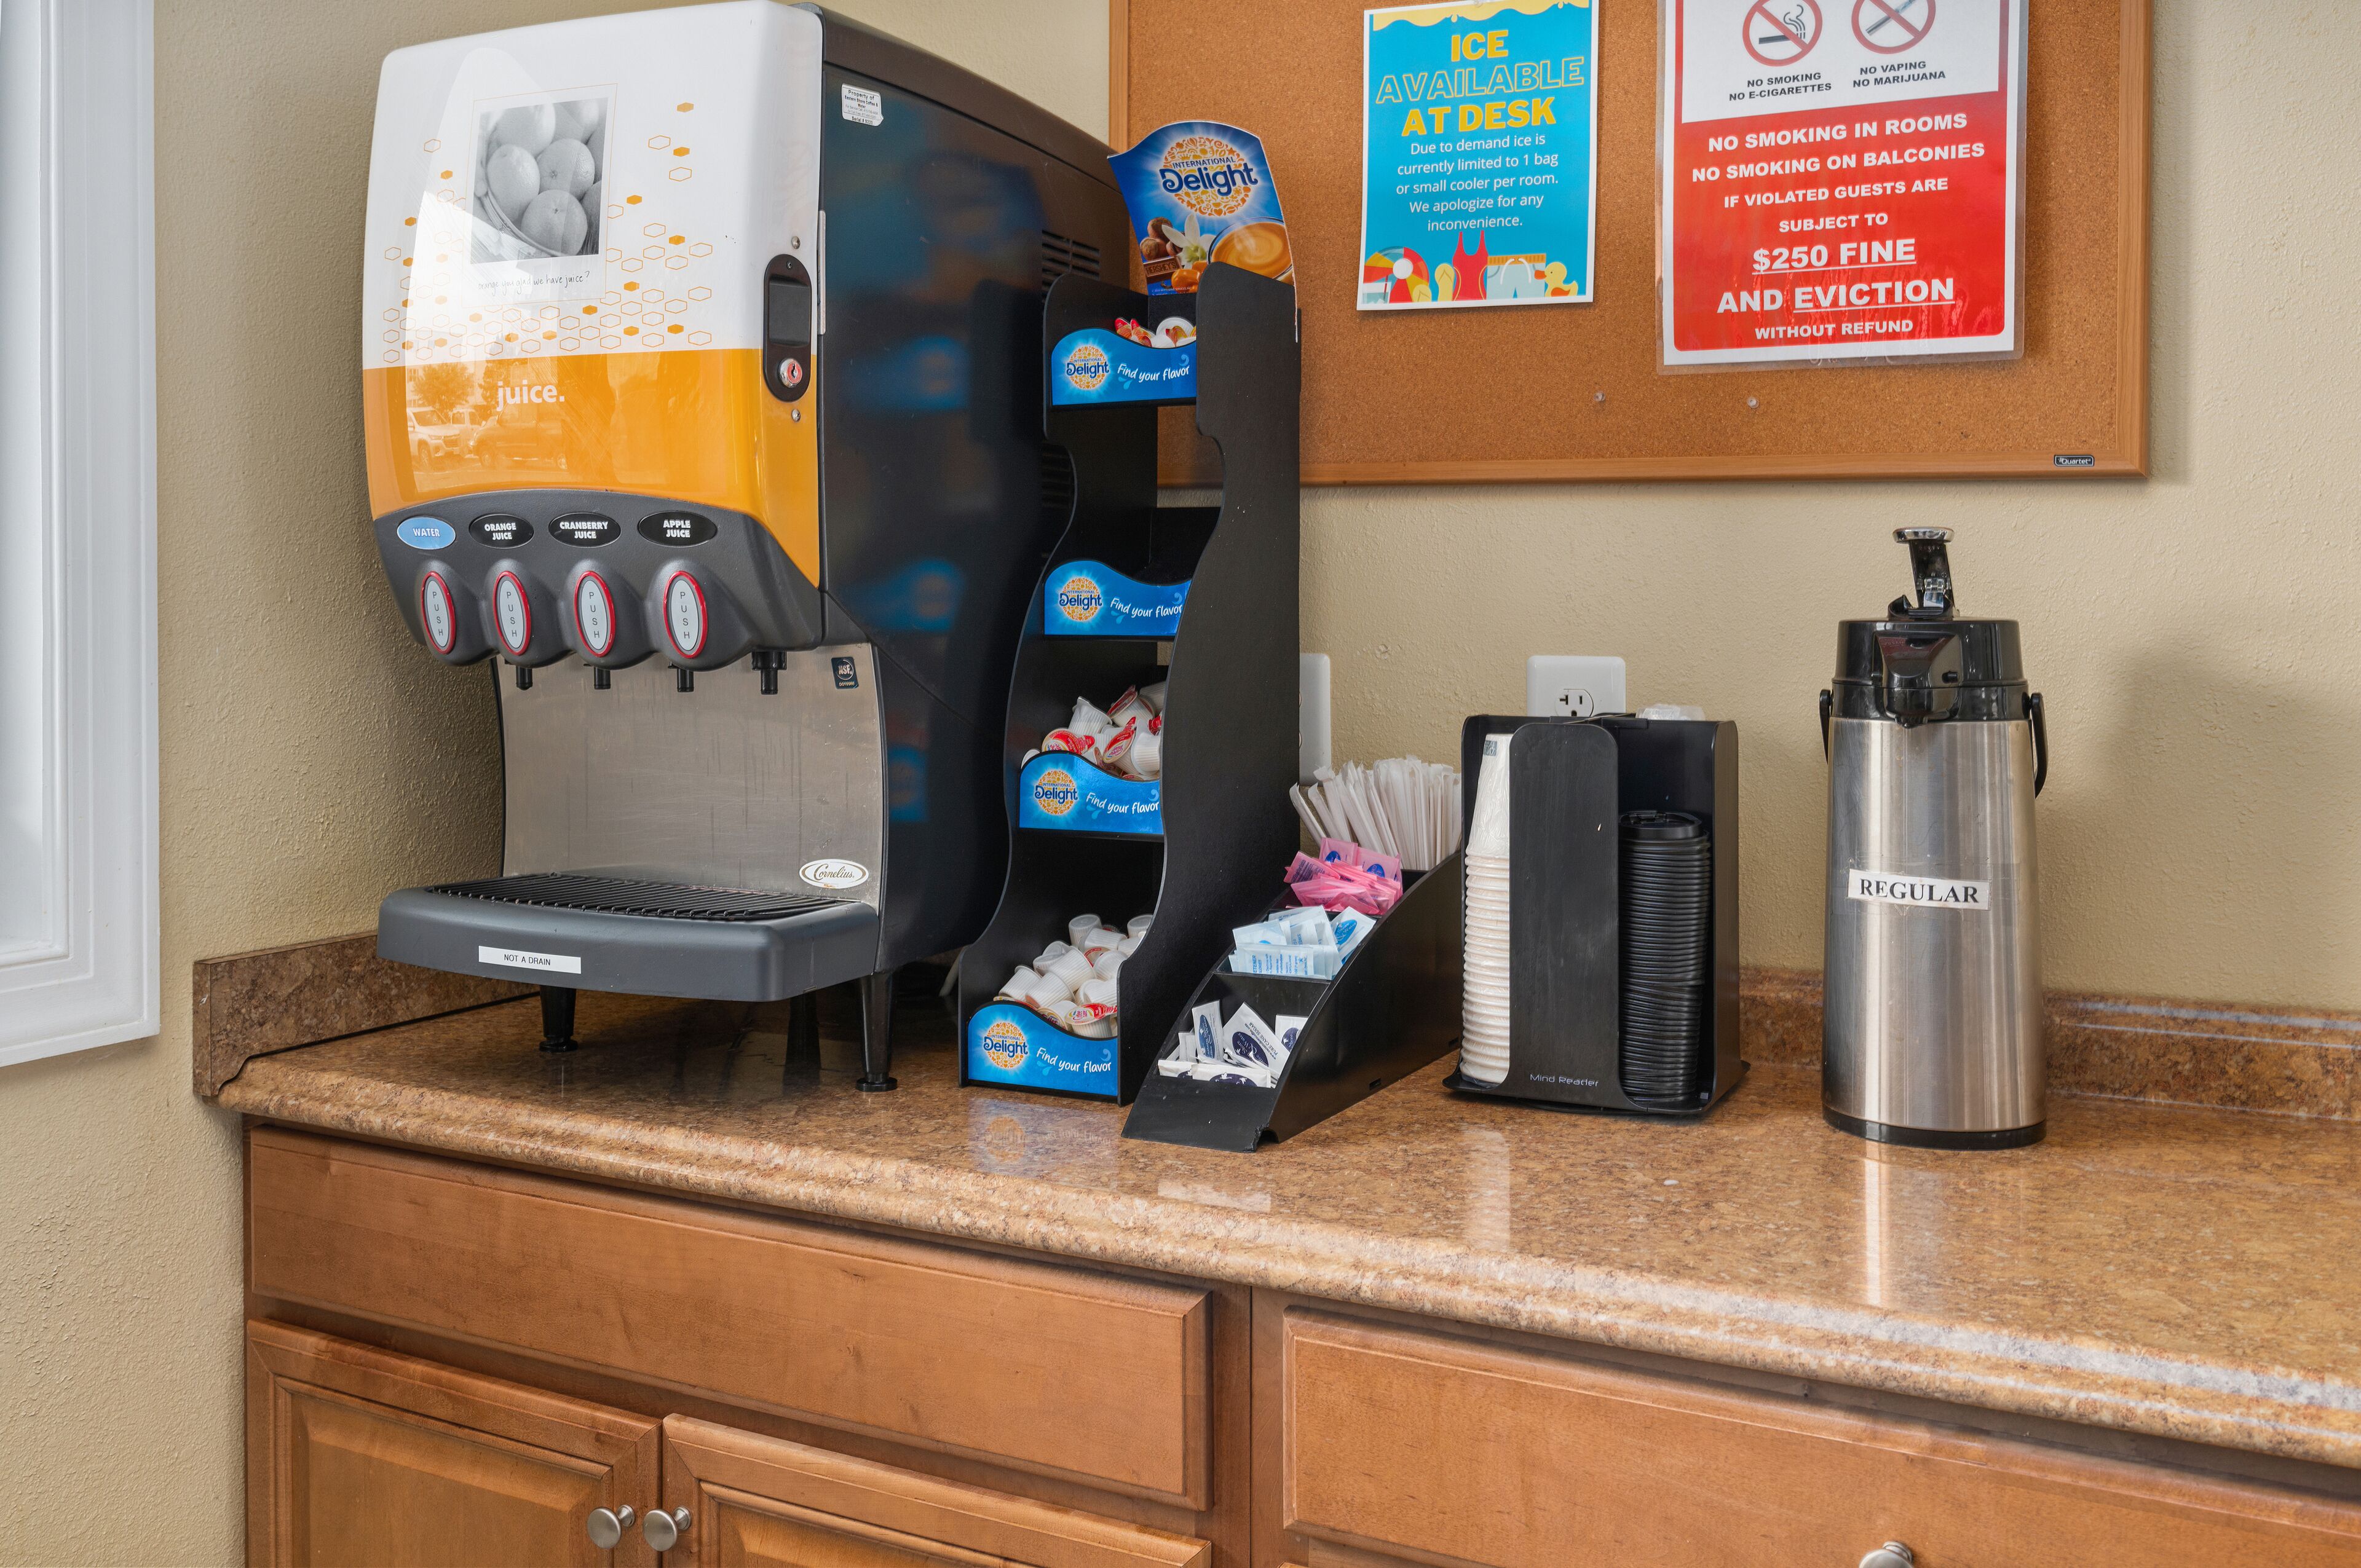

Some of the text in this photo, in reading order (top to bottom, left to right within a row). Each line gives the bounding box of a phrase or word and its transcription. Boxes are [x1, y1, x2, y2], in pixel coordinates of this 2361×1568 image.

[1450, 30, 1509, 61] ICE
[1860, 61, 1926, 75] NO VAPING
[1375, 57, 1584, 104] AVAILABLE
[1747, 72, 1822, 88] NO SMOKING
[1853, 71, 1946, 88] NO MARIJUANA
[848, 90, 868, 100] Property
[1729, 83, 1832, 101] NO E-CIGARETTES
[1401, 97, 1557, 136] AT DESK
[1709, 112, 1968, 152] NO SMOKING IN ROOMS
[1410, 134, 1546, 155] Due to demand ice is
[1173, 157, 1236, 169] INTERNATIONAL
[1397, 152, 1559, 176] currently limited to 1 bag
[1692, 143, 1985, 182] NO SMOKING ON BALCONIES
[1159, 162, 1259, 197] Delight
[1396, 174, 1559, 194] or small cooler per room.
[1724, 178, 1948, 208] IF VIOLATED GUESTS ARE
[1409, 195, 1544, 215] We apologize for any
[1428, 216, 1523, 231] inconvenience.
[1779, 213, 1888, 232] SUBJECT TO
[1752, 238, 1916, 272] $250 FINE
[478, 280, 498, 296] orange
[501, 281, 515, 295] you
[516, 275, 531, 294] glad
[546, 274, 562, 284] have
[1717, 278, 1955, 313] AND EVICTION
[1755, 320, 1913, 340] WITHOUT REFUND
[1066, 361, 1110, 379] Delight
[1117, 364, 1190, 383] Find your flavor
[496, 379, 565, 412] juice.
[413, 528, 440, 537] WATER
[484, 522, 516, 532] ORANGE
[663, 519, 691, 529] APPLE
[666, 529, 690, 538] JUICE
[492, 532, 512, 540] JUICE
[1059, 593, 1102, 611] Delight
[1110, 597, 1183, 618] Find your flavor
[432, 591, 444, 637] PUSH
[506, 591, 518, 637] PUSH
[588, 592, 600, 638] PUSH
[680, 592, 690, 639] PUSH
[838, 664, 850, 674] NSF
[1034, 785, 1078, 805] Delight
[1086, 792, 1159, 814] Find your flavor
[813, 864, 853, 880] Cornelius
[1860, 878, 1979, 904] REGULAR
[529, 956, 551, 966] DRAIN
[983, 1036, 1029, 1058] Delight
[1249, 1022, 1278, 1056] PURE CANE SUGAR
[1036, 1047, 1112, 1074] Find your flavor
[1530, 1074, 1599, 1087] Mind Reader
